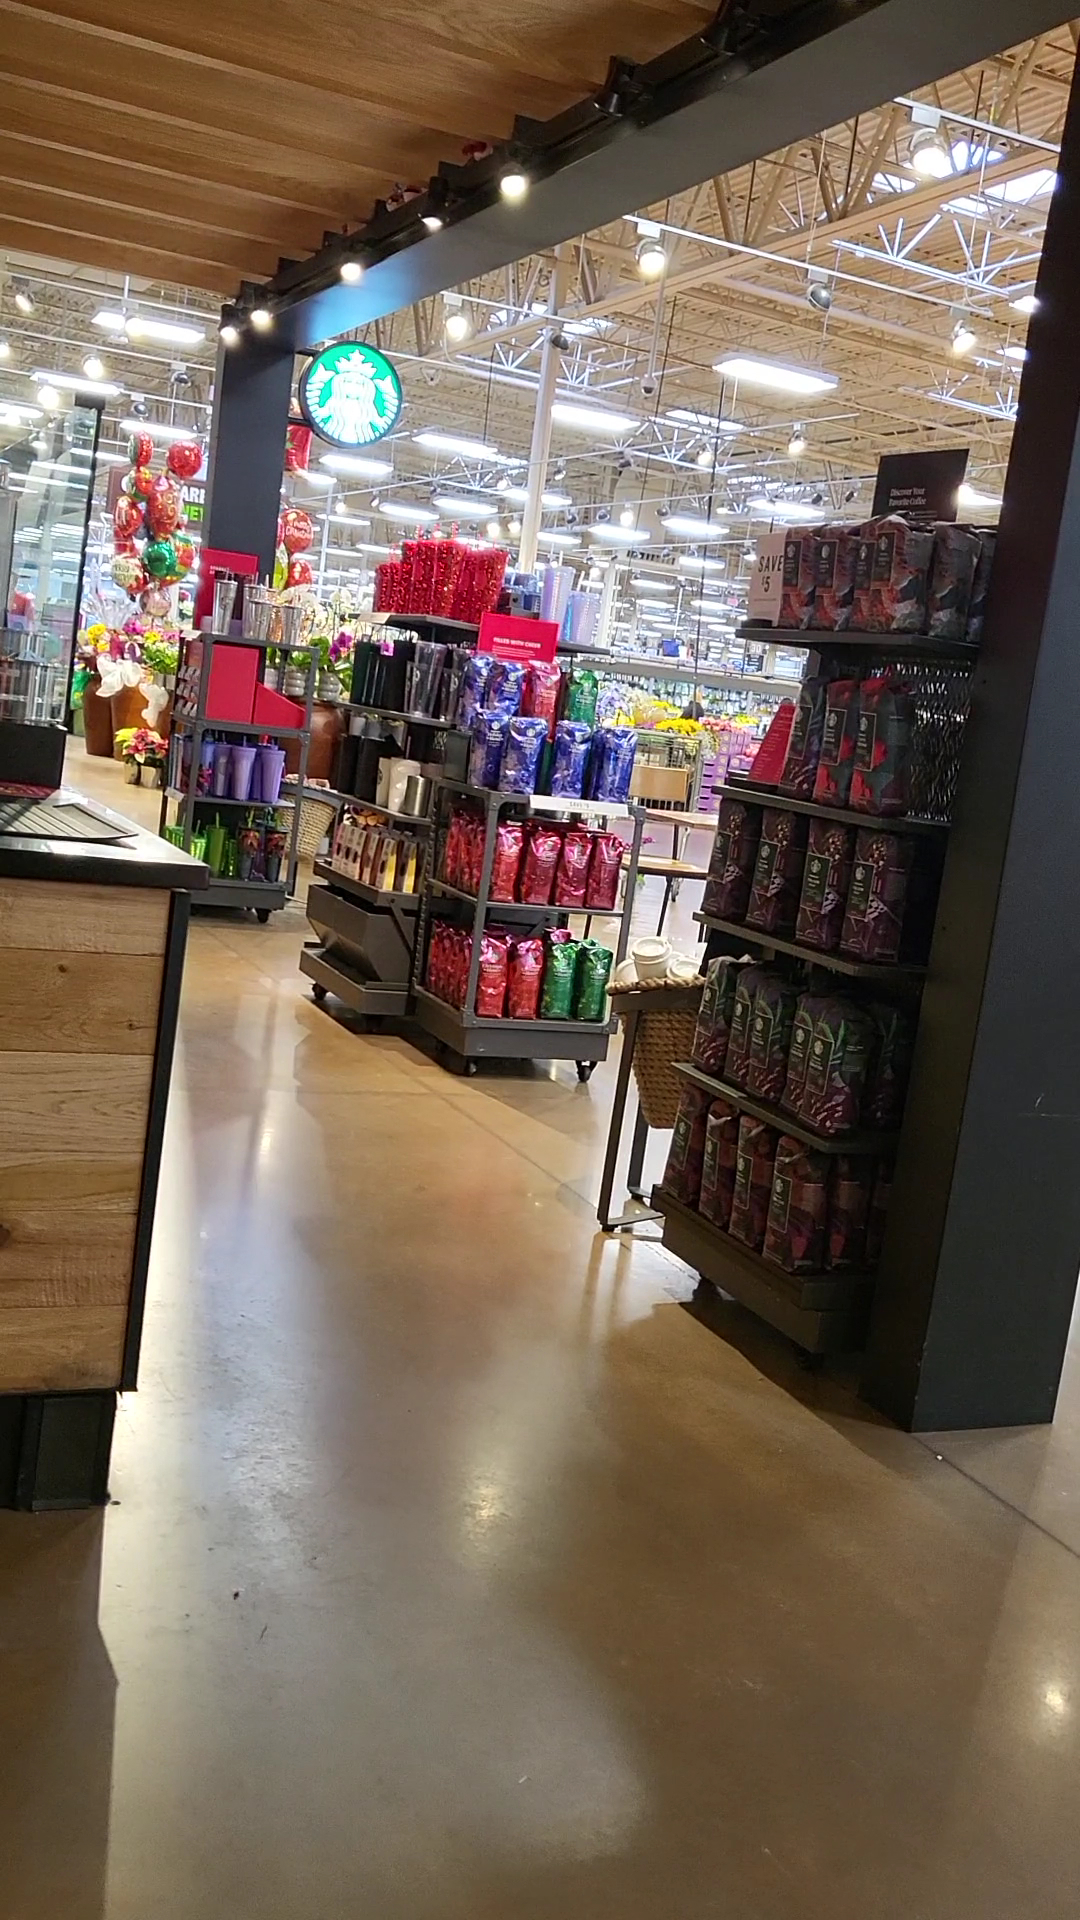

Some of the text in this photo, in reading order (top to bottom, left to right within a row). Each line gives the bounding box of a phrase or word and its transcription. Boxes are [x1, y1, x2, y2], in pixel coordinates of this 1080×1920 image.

[890, 488, 912, 496] Discover
[889, 496, 926, 506] Favorite Coffee
[758, 555, 784, 573] SAVE
[761, 576, 771, 592] $5
